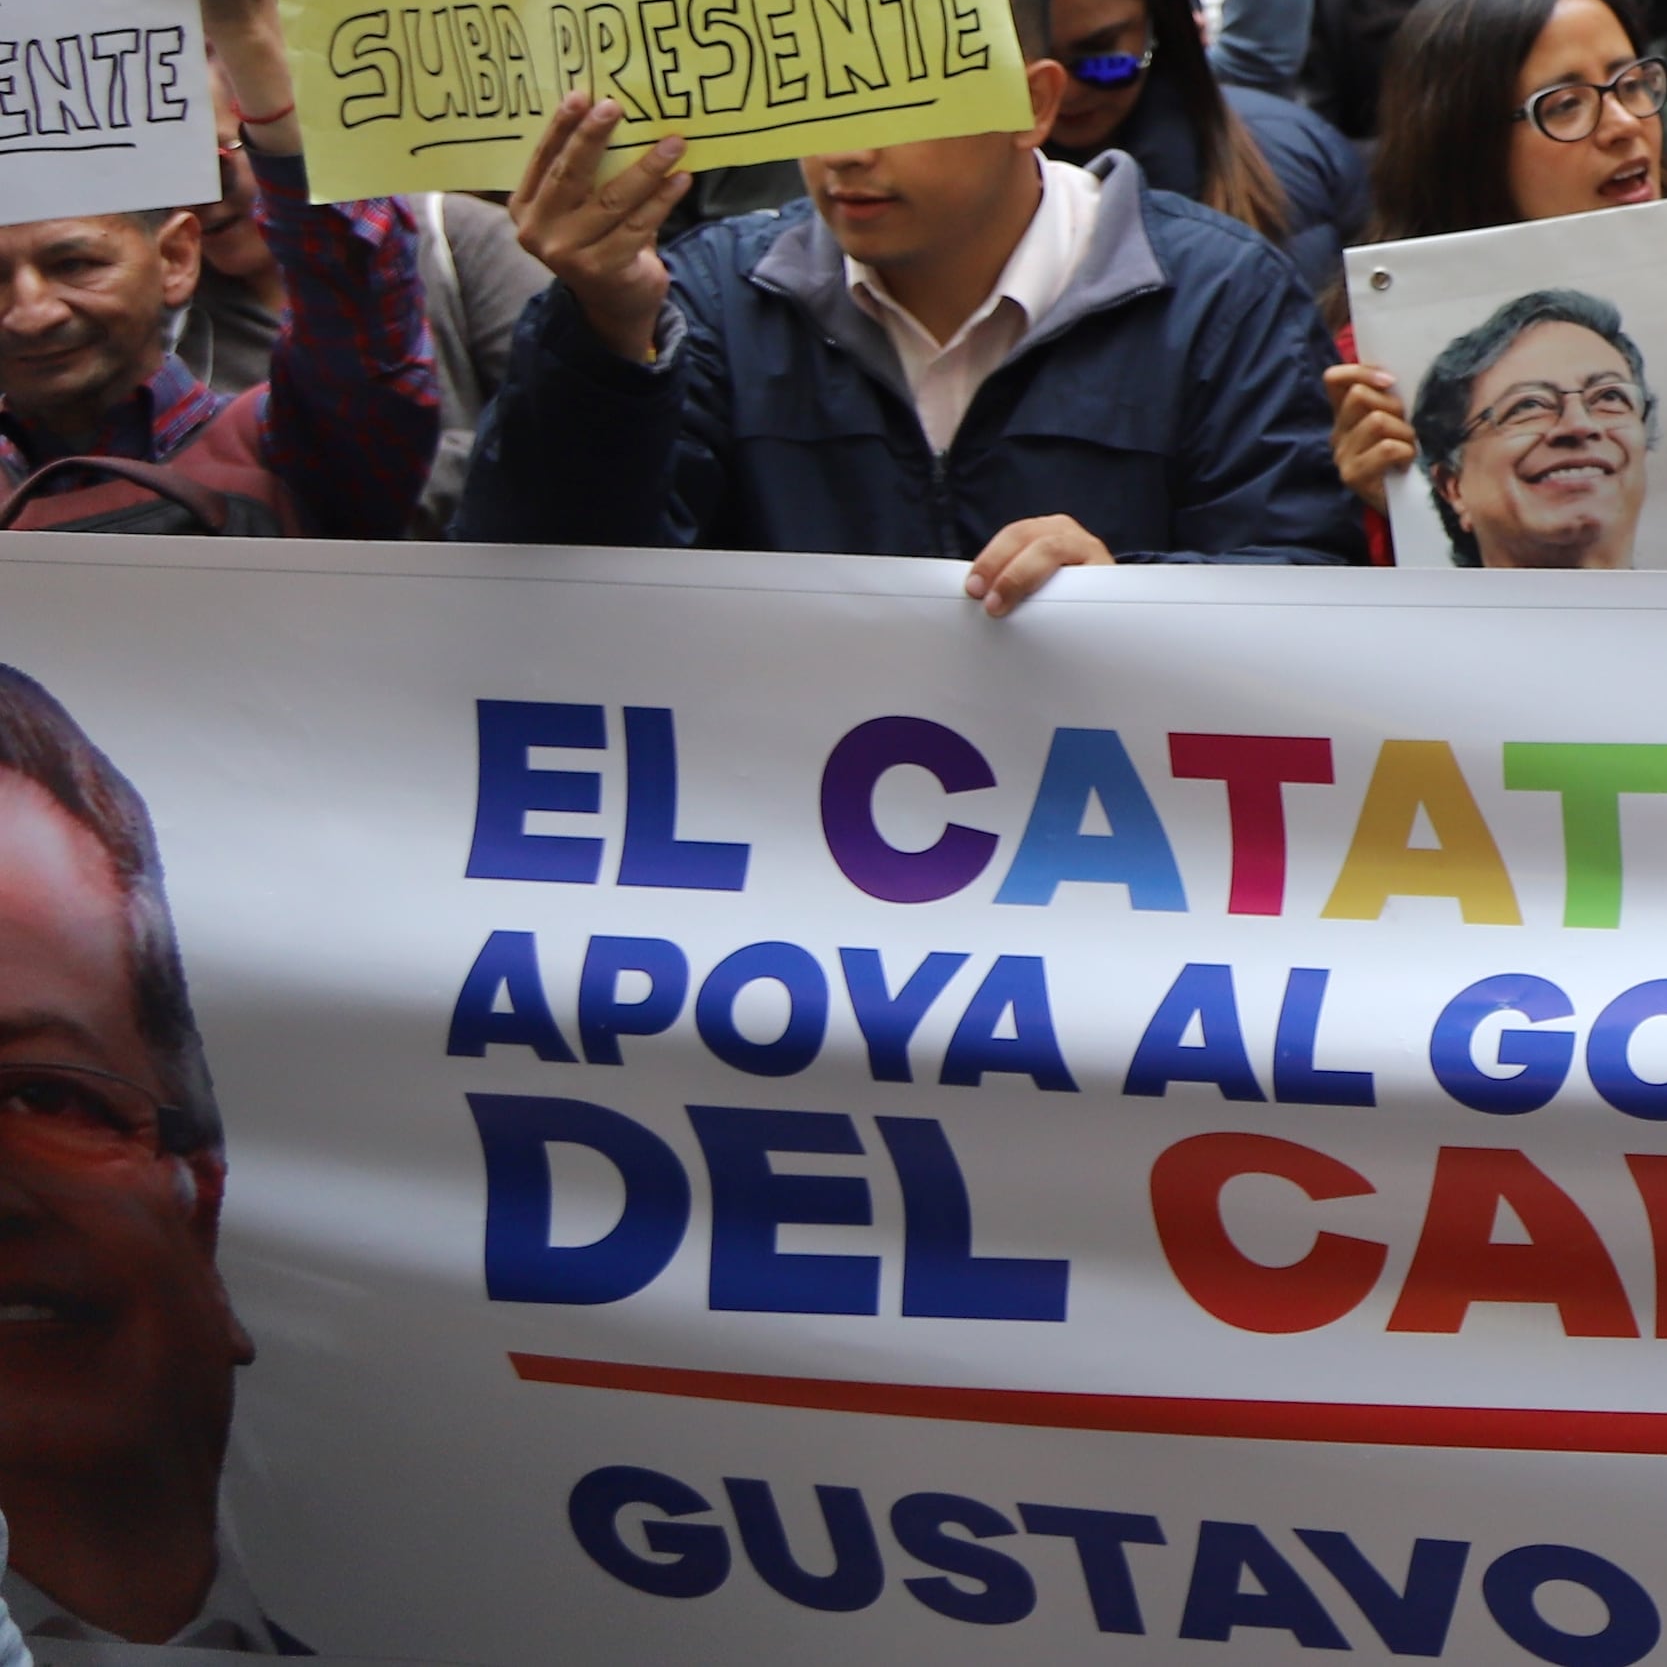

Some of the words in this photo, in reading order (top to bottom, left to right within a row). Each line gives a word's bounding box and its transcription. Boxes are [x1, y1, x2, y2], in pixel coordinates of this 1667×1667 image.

[329, 4, 538, 129] SUBA
[465, 699, 751, 892] EL
[446, 931, 1080, 1094] APOYA
[1123, 962, 1377, 1107] AL
[465, 1092, 1071, 1323] DEL
[568, 1465, 1662, 1667] GUSTAVO
